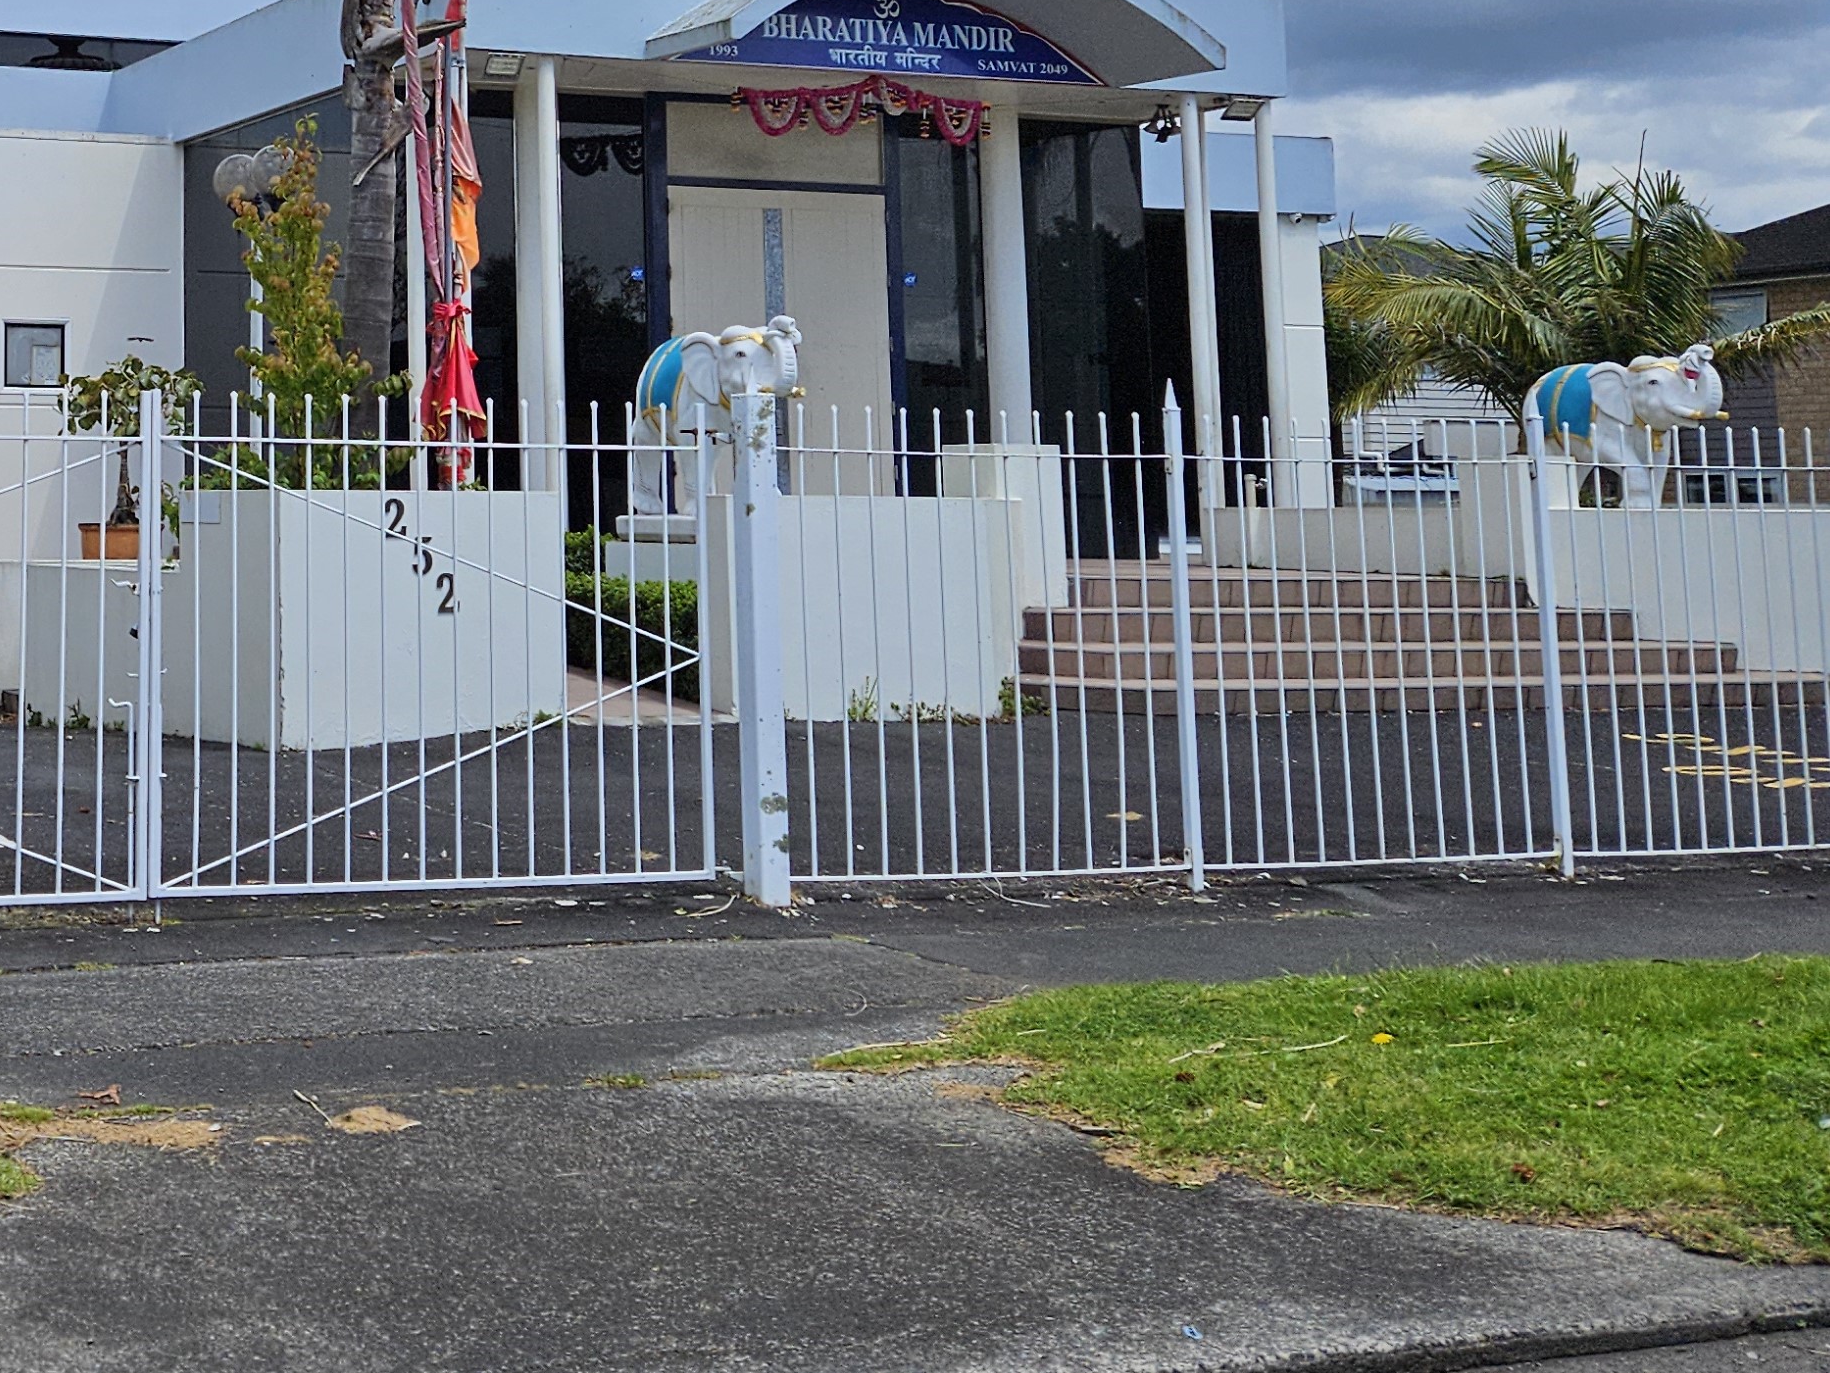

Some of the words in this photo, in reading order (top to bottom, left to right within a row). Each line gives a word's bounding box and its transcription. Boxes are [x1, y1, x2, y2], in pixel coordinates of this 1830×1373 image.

[762, 13, 909, 47] BHARATIYA
[913, 21, 1016, 54] MANDIR
[708, 44, 739, 58] 1993
[828, 45, 888, 68] भारतीय
[893, 47, 942, 71] मन्दिर
[977, 58, 1037, 74] SAMVAT
[1040, 62, 1069, 75] 2049
[384, 497, 461, 614] 252
